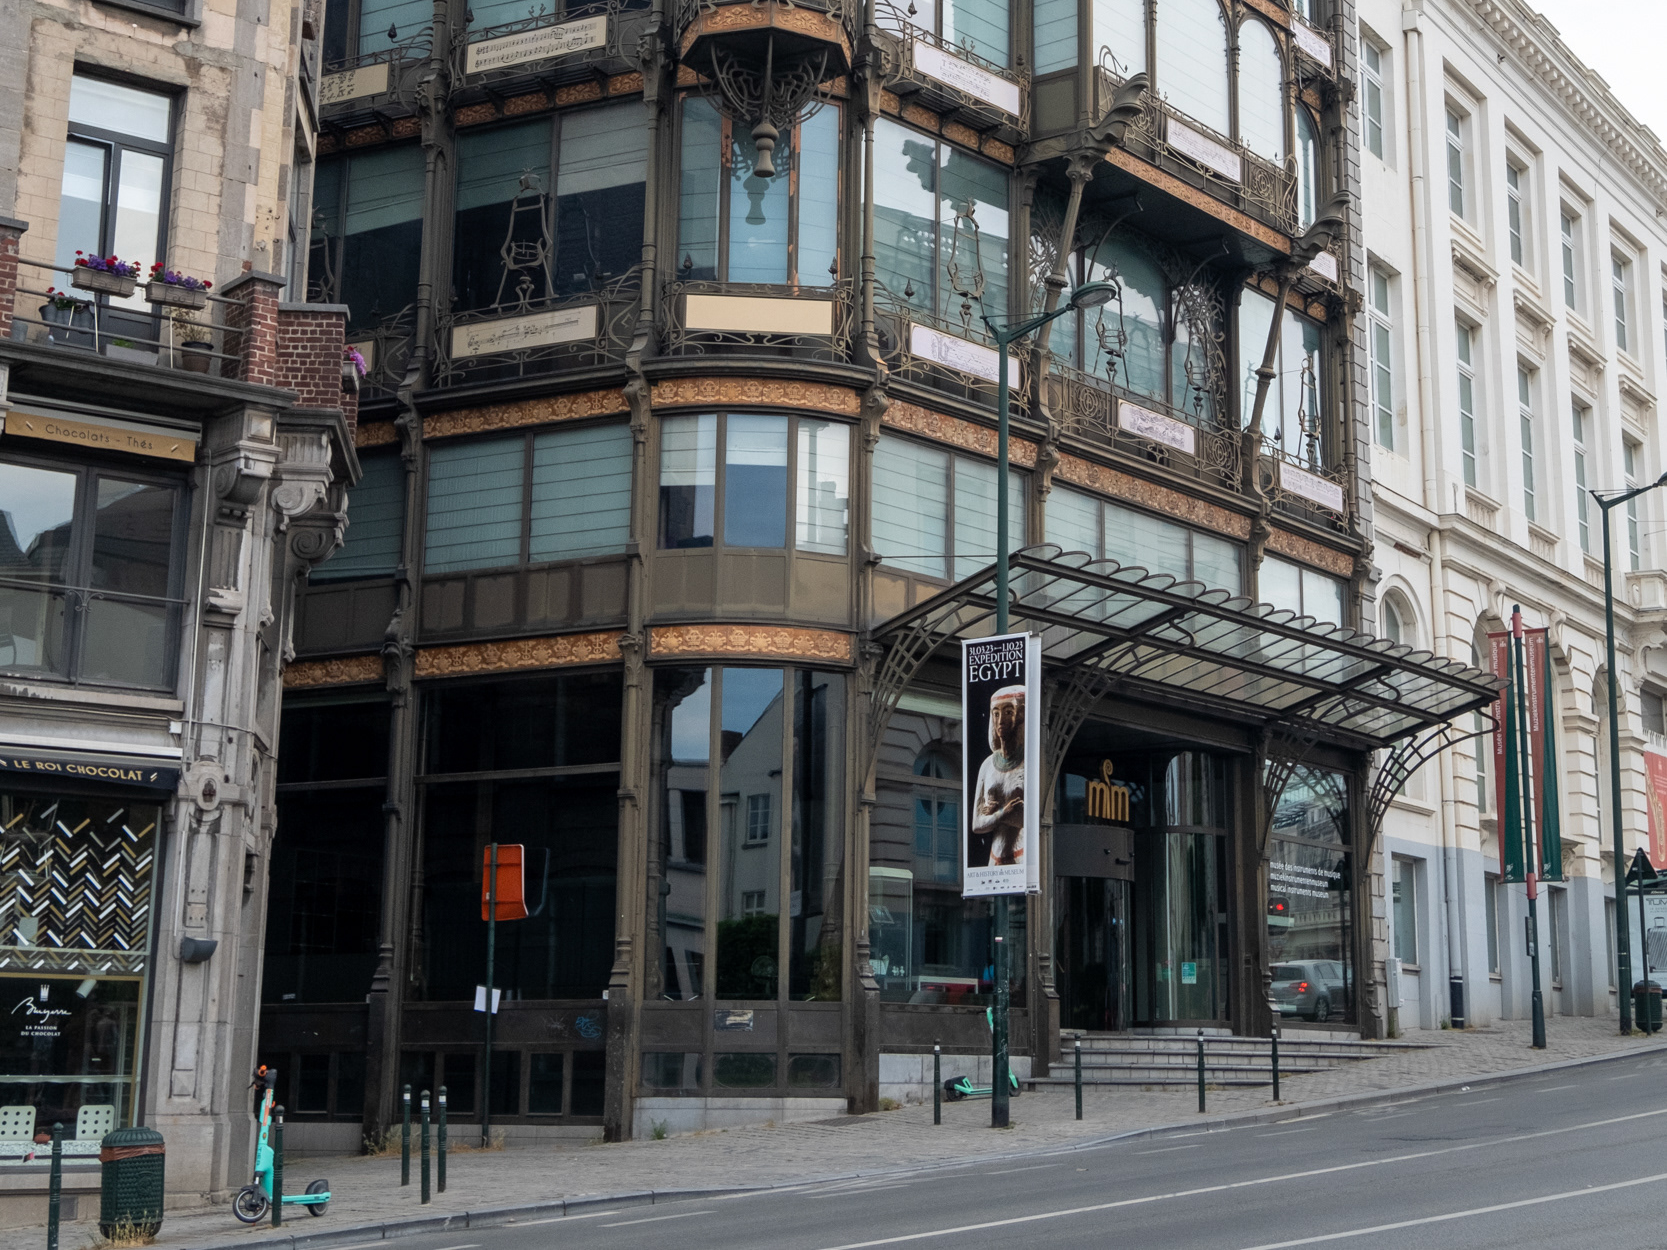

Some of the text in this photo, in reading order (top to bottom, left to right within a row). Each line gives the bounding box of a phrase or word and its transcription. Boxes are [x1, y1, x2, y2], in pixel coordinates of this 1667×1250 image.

[45, 423, 110, 443] Chocolats
[126, 435, 153, 450] Thés
[969, 641, 1023, 655] 31.03.23 1.10.23
[969, 650, 1023, 665] EXPEDITION
[1491, 641, 1499, 670] musique
[969, 660, 1024, 683] EGYPT
[13, 759, 143, 781] LE ROI CHOCOLAT
[1088, 759, 1130, 822] mim
